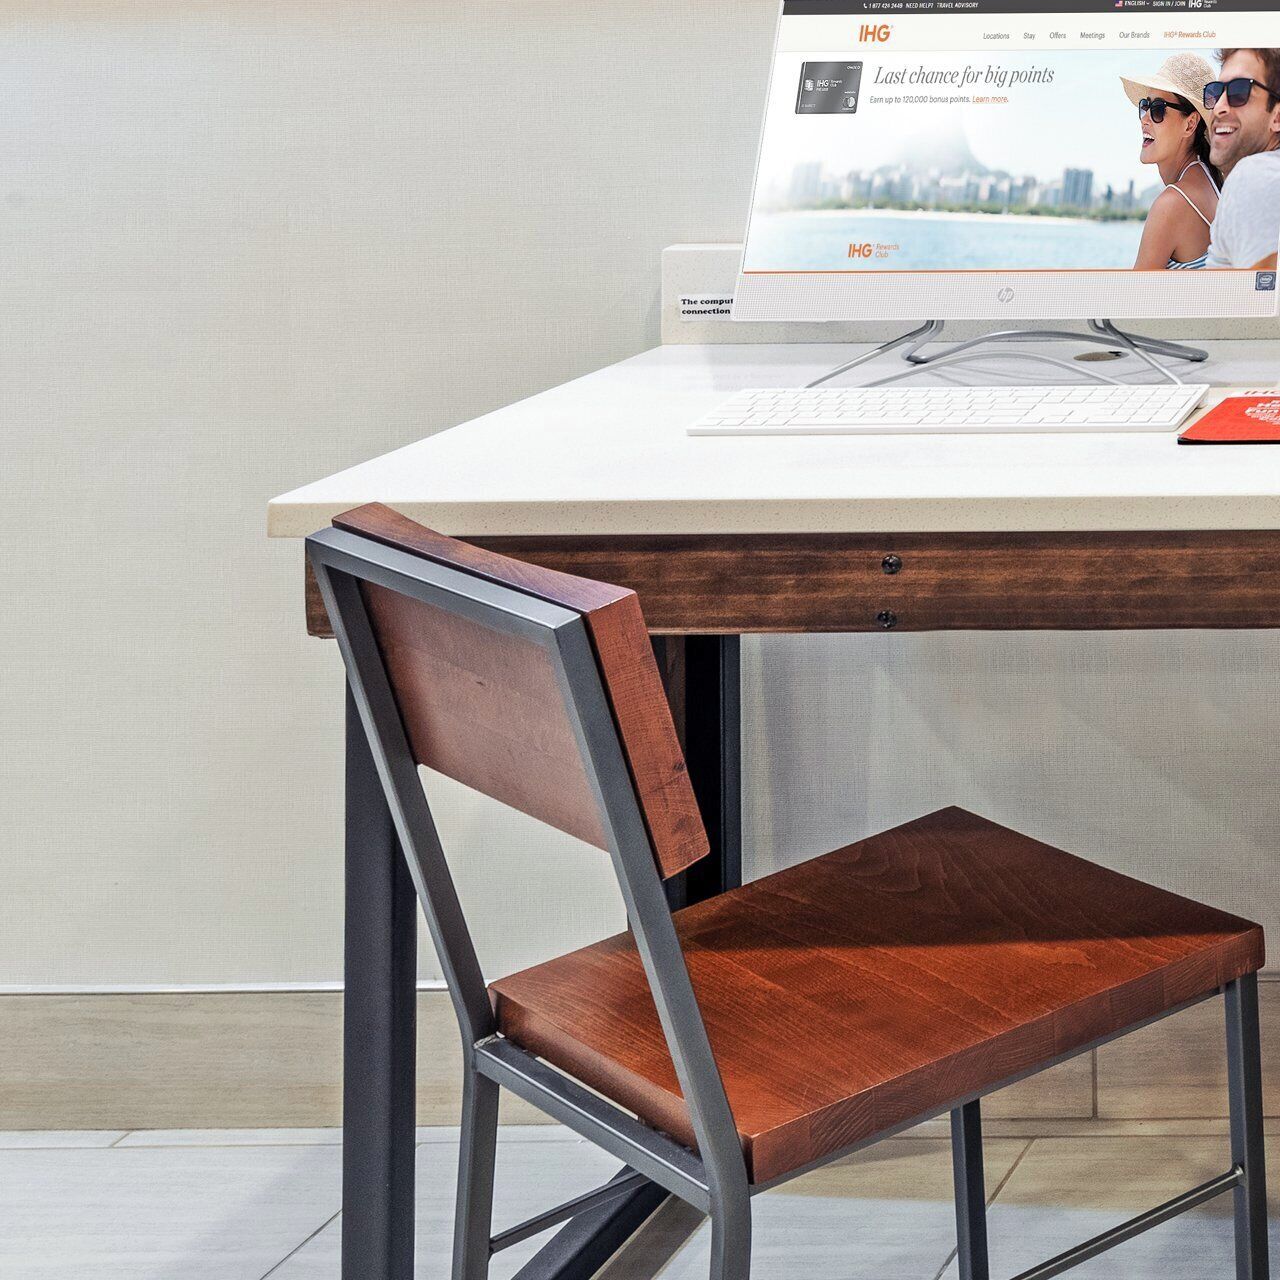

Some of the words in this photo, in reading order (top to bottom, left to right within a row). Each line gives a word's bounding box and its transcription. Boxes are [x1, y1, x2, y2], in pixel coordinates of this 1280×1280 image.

[1188, 0, 1203, 8] IHG
[983, 32, 1010, 40] Locations
[1023, 32, 1036, 40] Stay
[1080, 31, 1105, 40] Meetings
[1131, 31, 1150, 39] Brands
[874, 66, 905, 85] Last
[908, 65, 959, 85] chance
[958, 65, 983, 89] for
[984, 65, 1008, 88] big
[1008, 65, 1055, 87] points
[902, 96, 928, 104] 120,000
[950, 95, 971, 104] points.
[848, 243, 873, 258] IHG
